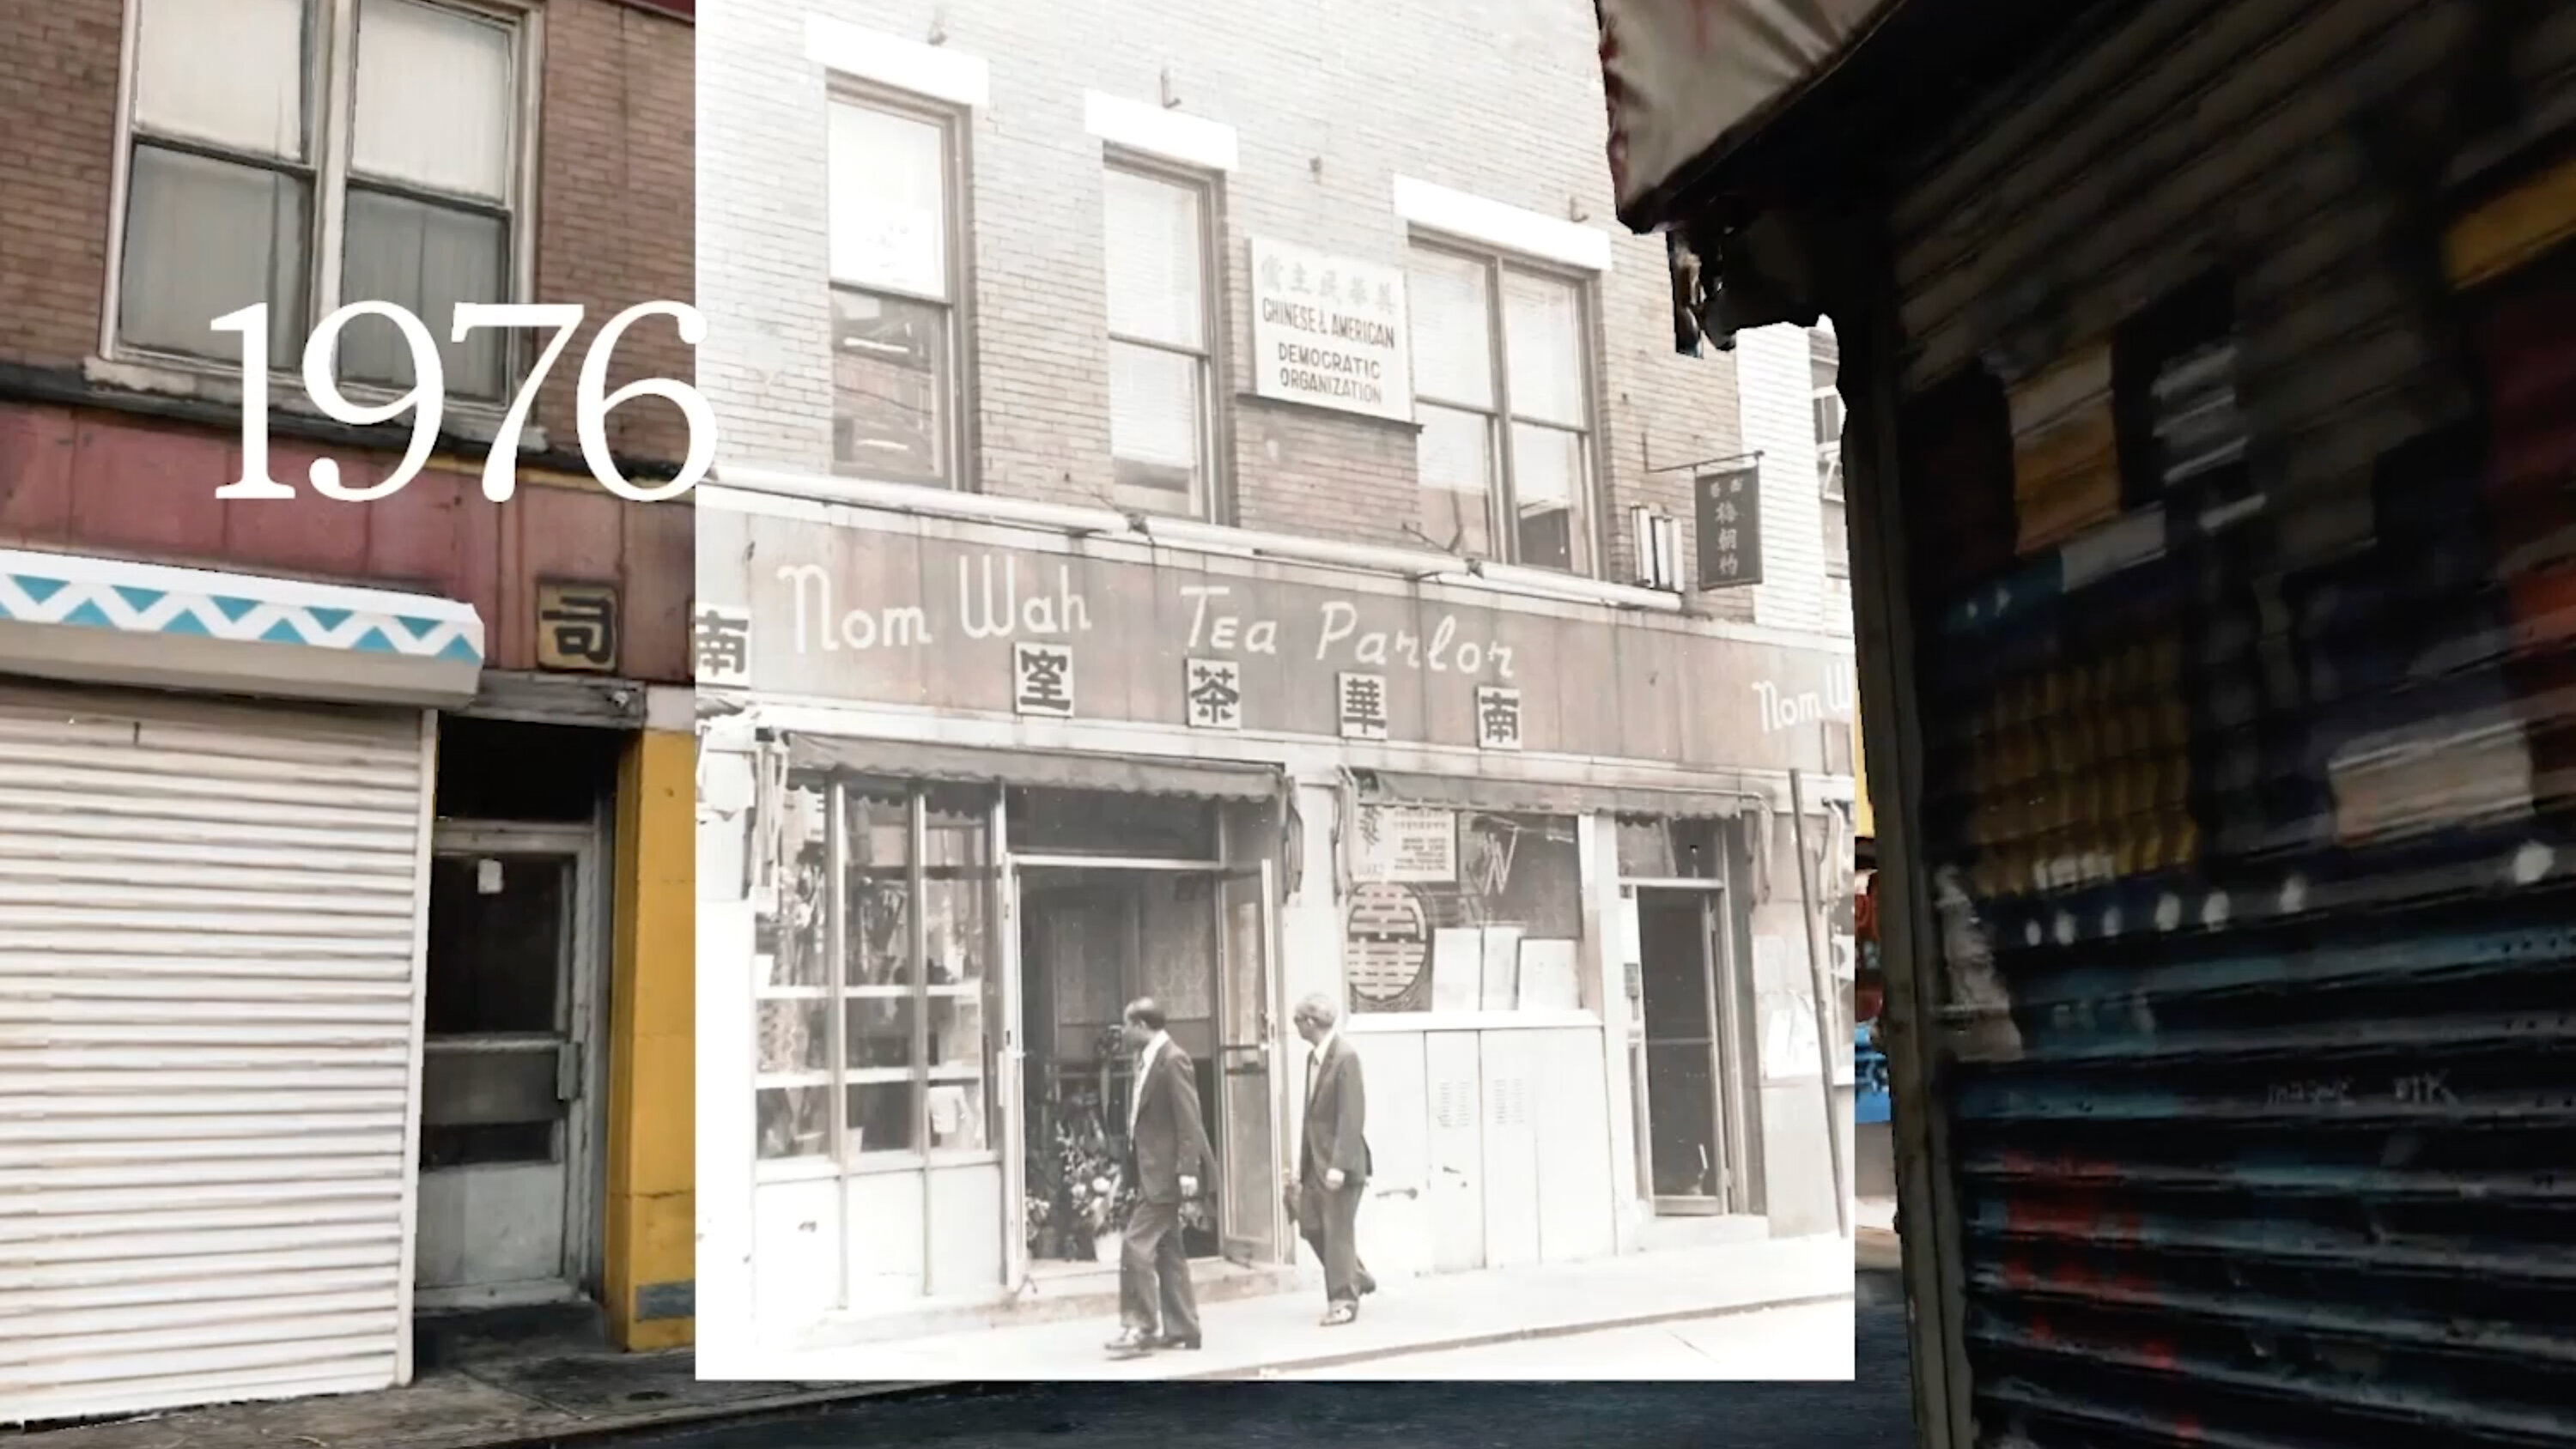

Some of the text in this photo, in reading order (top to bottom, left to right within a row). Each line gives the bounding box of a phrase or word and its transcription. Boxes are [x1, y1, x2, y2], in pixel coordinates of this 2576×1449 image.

[1262, 297, 1316, 333] CHINESE
[1332, 313, 1394, 350] AMERICAN
[1279, 343, 1381, 379] DEMOCRATIC
[1279, 367, 1382, 405] ORGANIZATION
[542, 597, 614, 664] 司
[776, 554, 1515, 677] Nom Wah Tea Parlor
[1751, 679, 1823, 732] Nom
